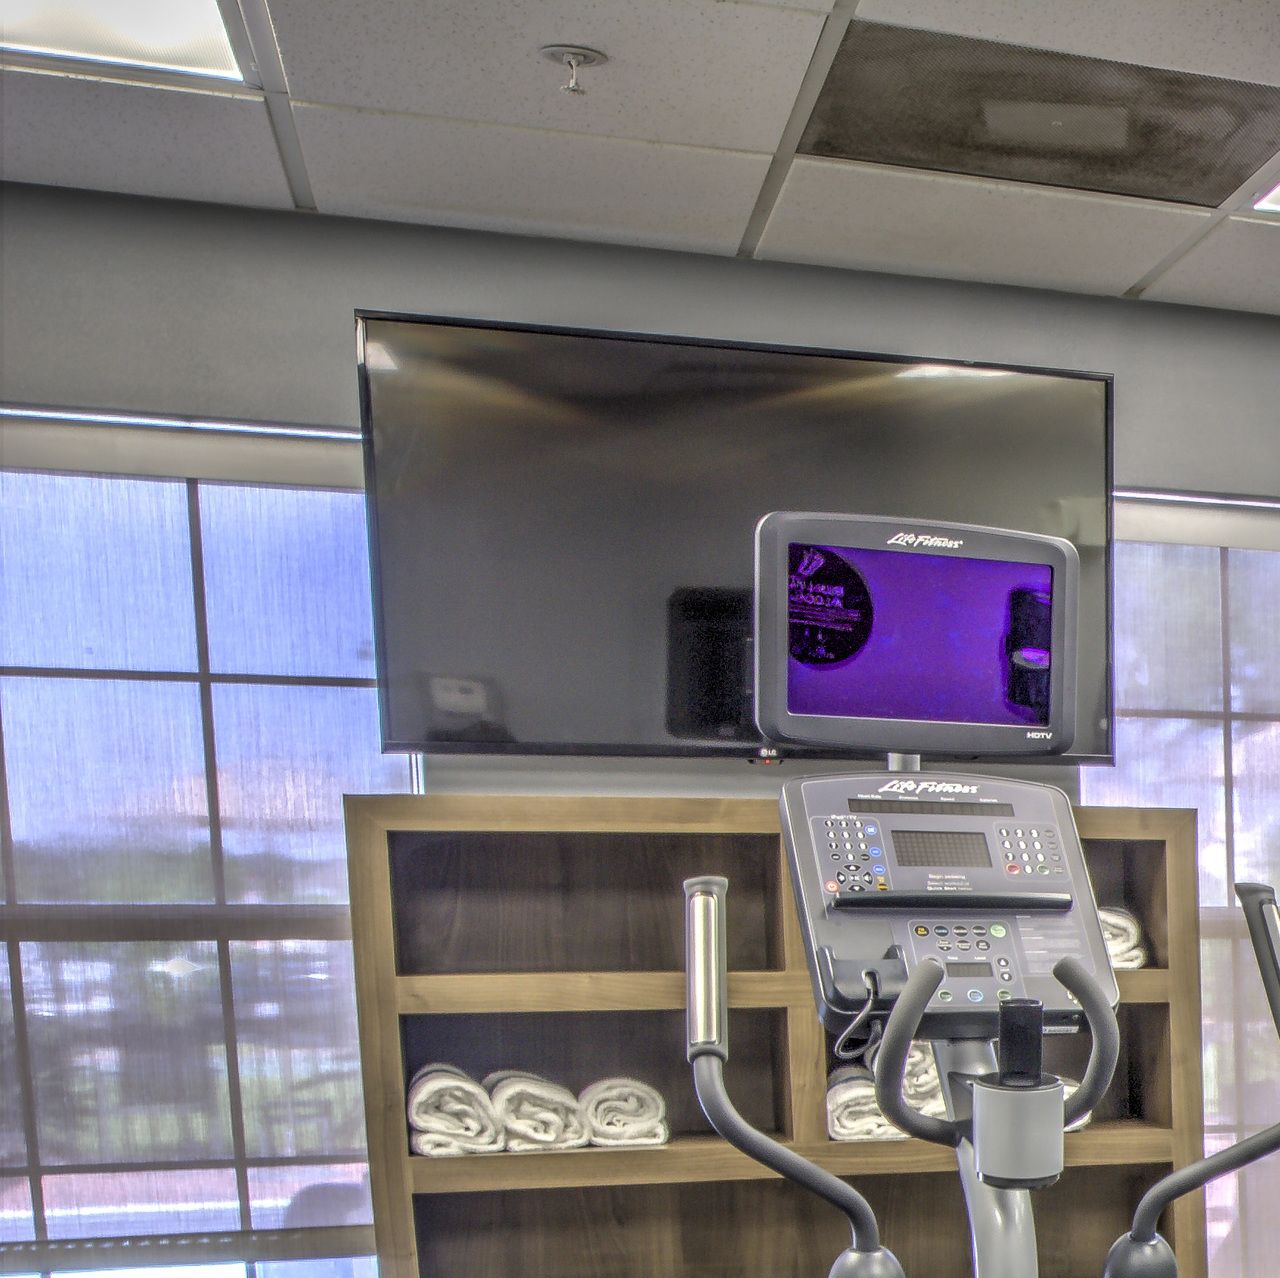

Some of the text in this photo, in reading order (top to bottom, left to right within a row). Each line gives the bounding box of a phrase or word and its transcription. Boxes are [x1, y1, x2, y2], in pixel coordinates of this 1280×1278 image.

[886, 532, 960, 549] Life Fitness
[1026, 731, 1053, 739] HDTV
[877, 780, 979, 794] Life Fitness
